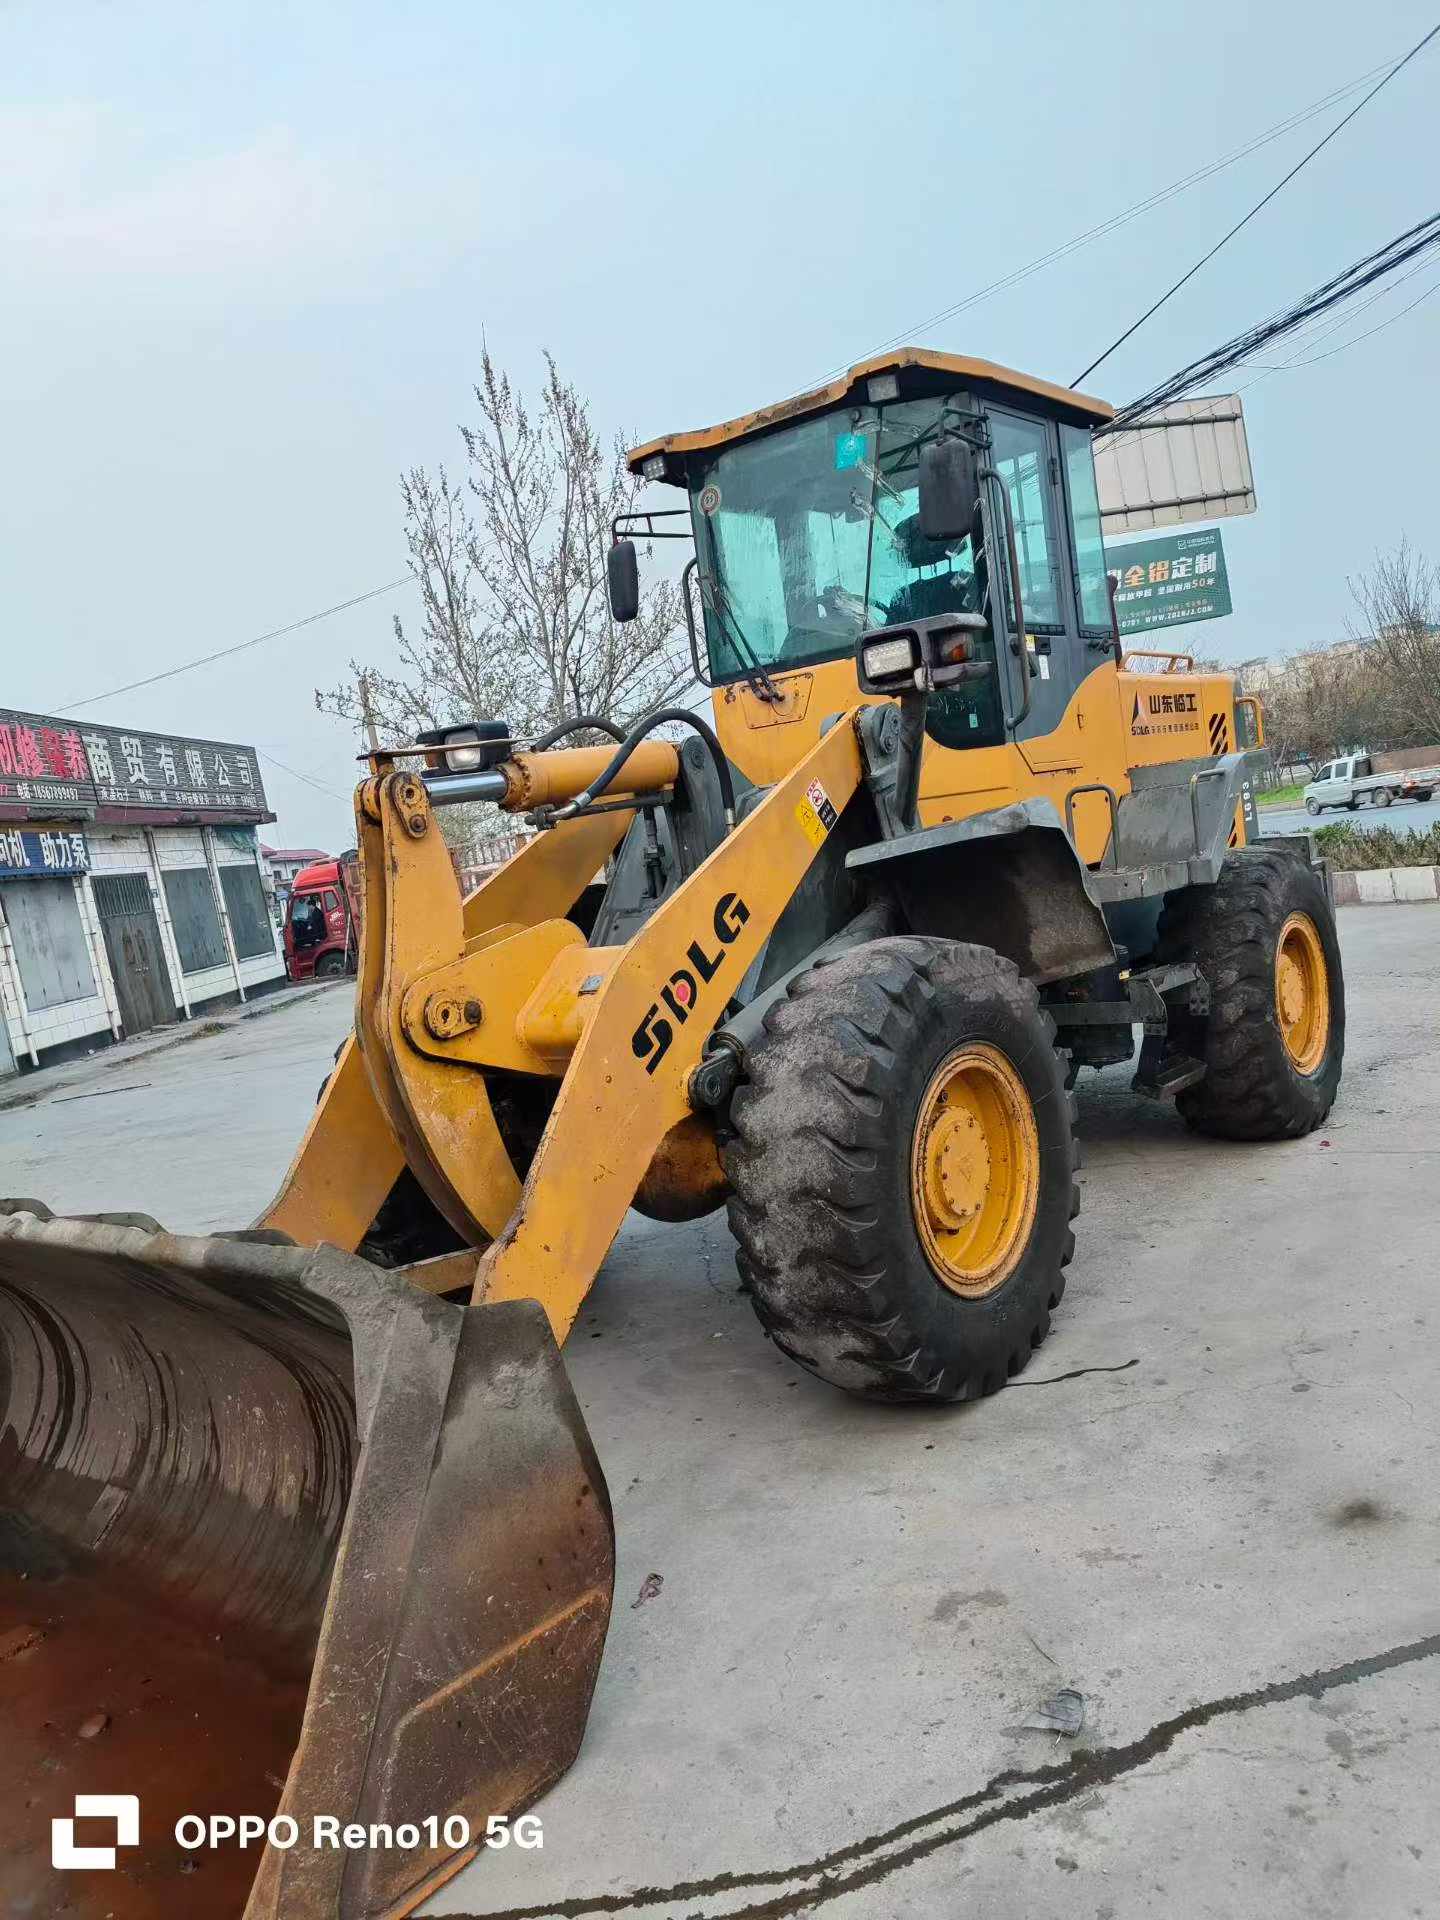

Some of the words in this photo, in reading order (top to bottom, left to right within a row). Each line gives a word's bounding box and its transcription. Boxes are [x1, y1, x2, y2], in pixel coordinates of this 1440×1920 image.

[1149, 693, 1198, 714] 山东临工
[81, 733, 255, 790] 商贸有限公司
[39, 831, 90, 870] 助力泵
[631, 892, 751, 1076] SDLG
